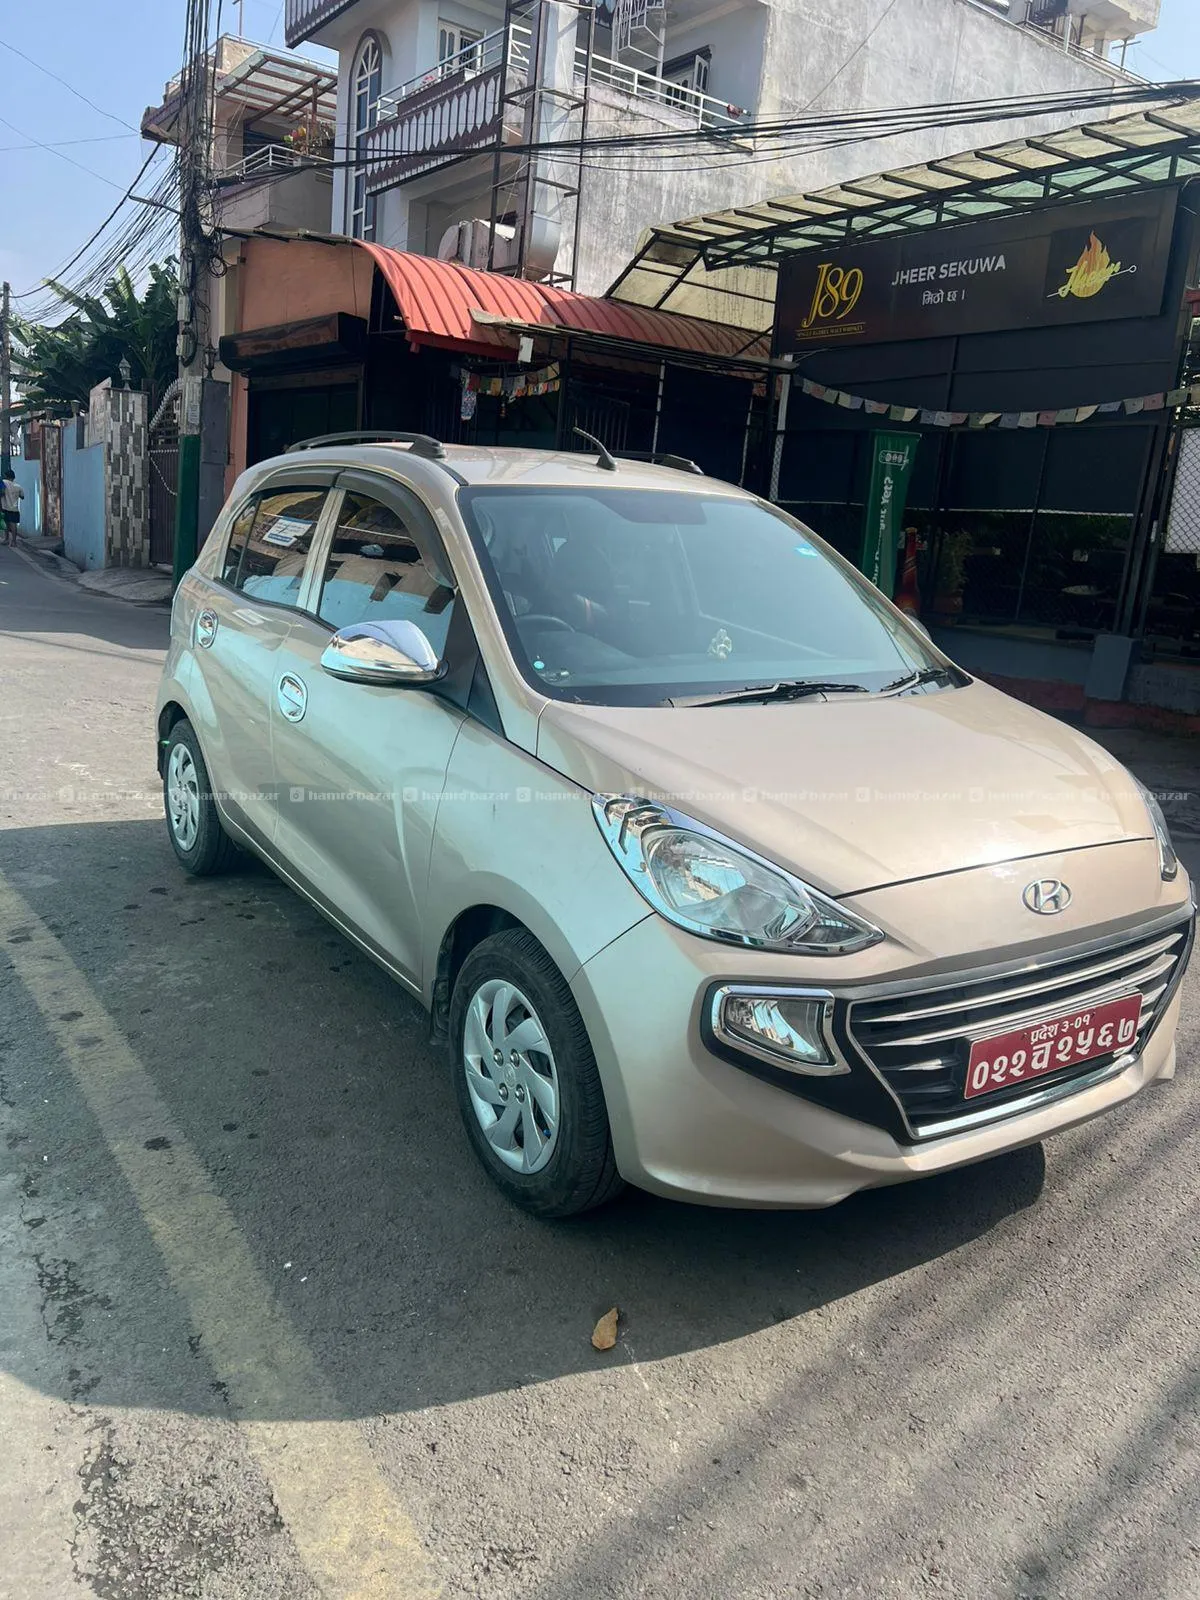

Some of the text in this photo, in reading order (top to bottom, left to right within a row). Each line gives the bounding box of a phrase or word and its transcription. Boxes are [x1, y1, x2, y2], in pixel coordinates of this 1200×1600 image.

[891, 254, 1006, 286] JHEER SEKUWA
[801, 263, 864, 328] J89
[881, 476, 894, 505] Yet?
[1030, 1023, 1059, 1045] प्रदेश
